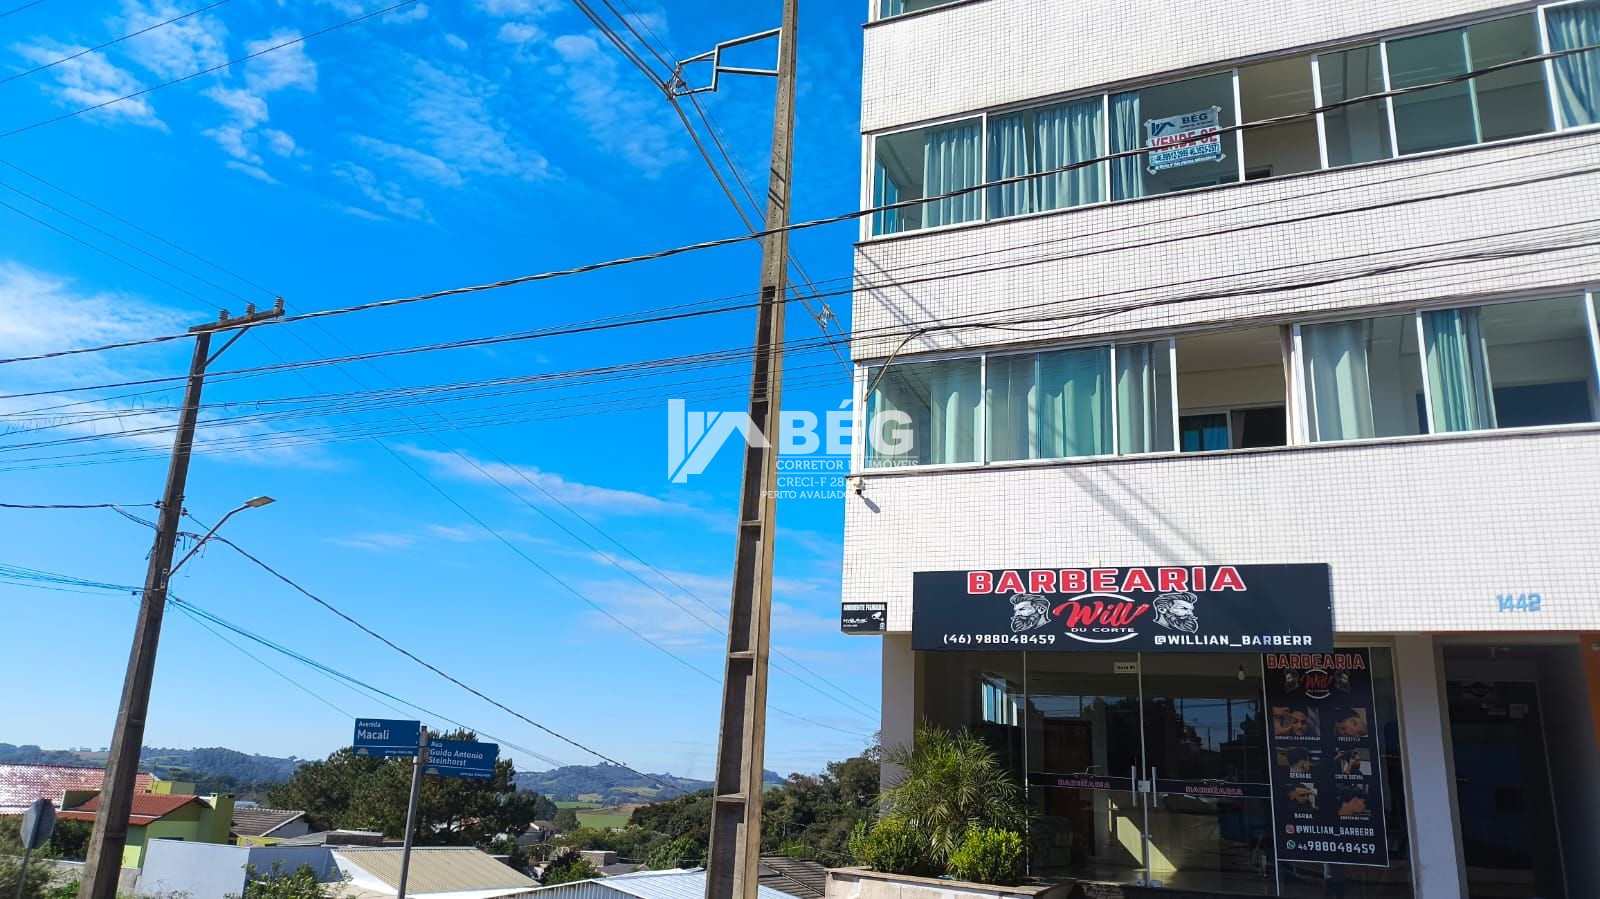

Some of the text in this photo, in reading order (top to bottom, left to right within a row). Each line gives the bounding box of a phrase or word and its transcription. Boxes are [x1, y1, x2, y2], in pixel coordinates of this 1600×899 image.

[967, 565, 1247, 595] BARBEARIA
[1496, 592, 1541, 613] 1442
[1052, 600, 1150, 628] Will
[943, 634, 1056, 646] (46) 988048459
[1154, 634, 1313, 647] @WILLIAN_BARBERR
[1266, 653, 1366, 670] BARBEARIA
[358, 720, 381, 728] Avenida
[357, 729, 390, 740] Macali
[429, 748, 484, 760] Guido Antonio
[428, 756, 467, 767] Steinhorst
